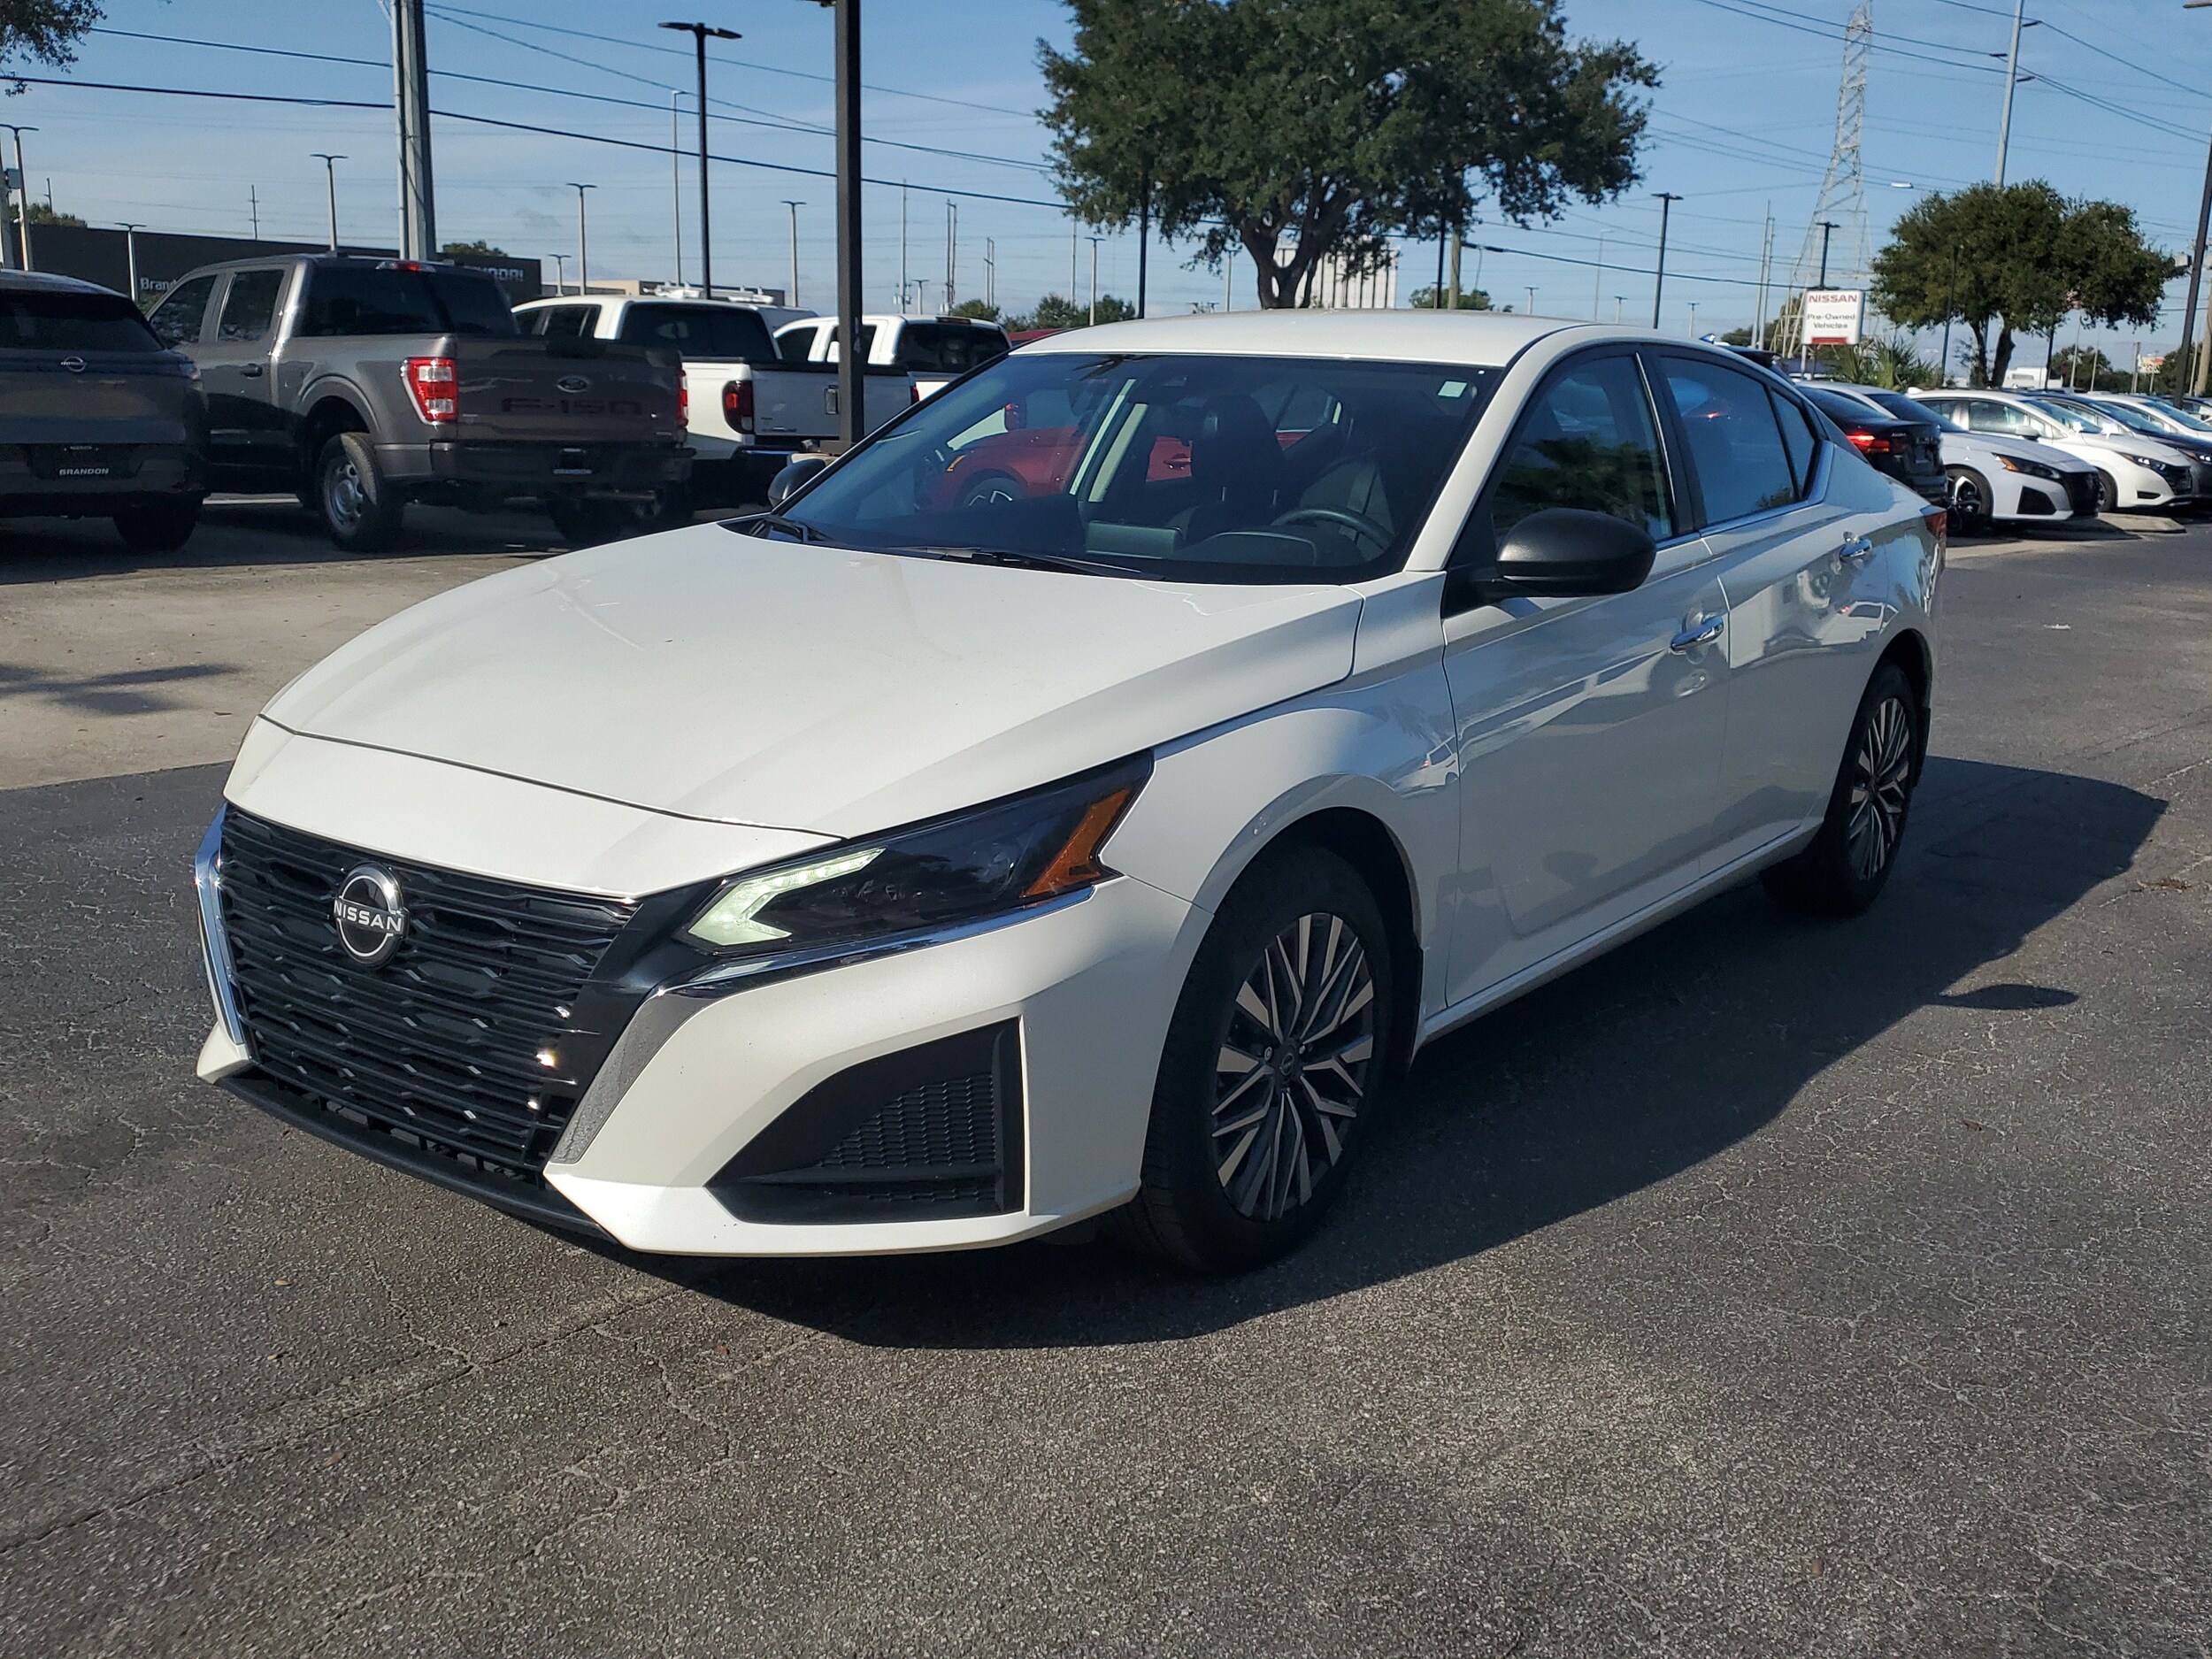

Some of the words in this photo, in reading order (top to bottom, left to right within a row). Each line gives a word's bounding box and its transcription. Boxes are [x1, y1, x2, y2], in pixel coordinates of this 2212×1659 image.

[1809, 294, 1857, 303] NISSAN
[502, 398, 642, 414] F-150
[59, 467, 109, 476] BRANDON
[334, 899, 402, 932] NISSAN
